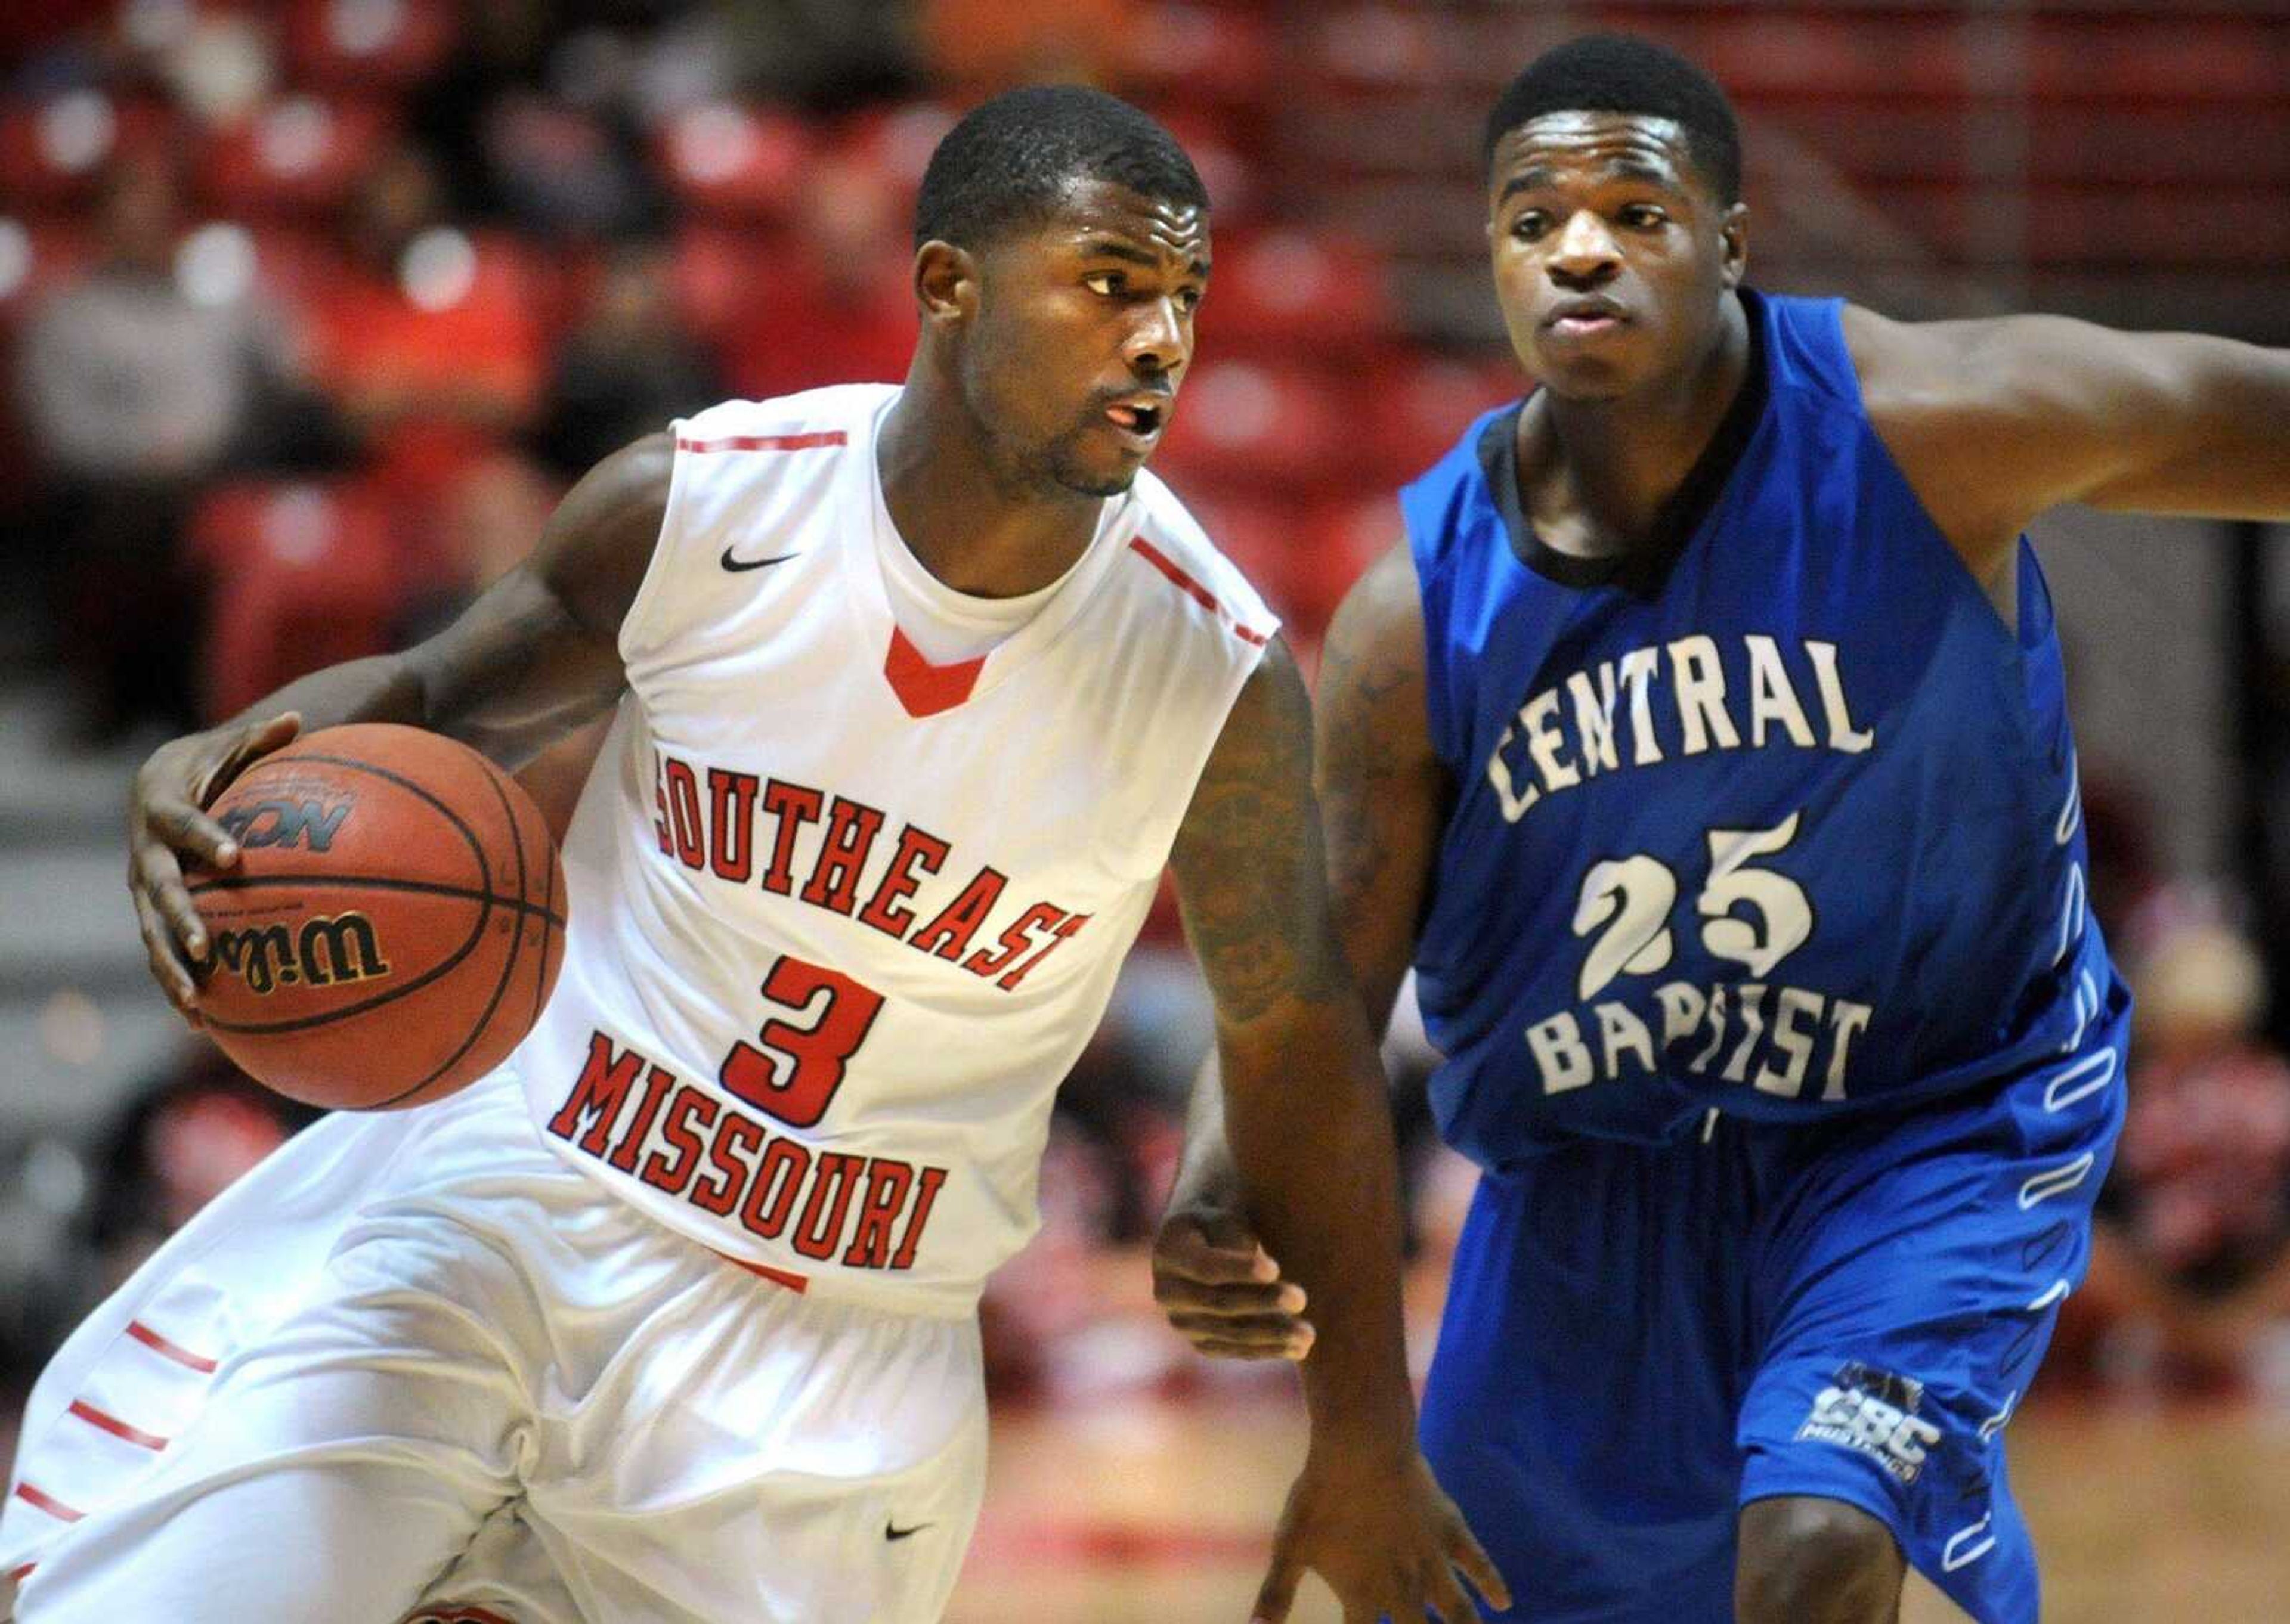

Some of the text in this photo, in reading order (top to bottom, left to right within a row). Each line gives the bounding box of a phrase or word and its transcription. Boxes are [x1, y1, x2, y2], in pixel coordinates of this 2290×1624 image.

[1486, 633, 1876, 825] CENTRAL
[1570, 810, 1814, 1003] 25
[719, 954, 887, 1130] 3
[546, 1029, 950, 1271] MISSOURI
